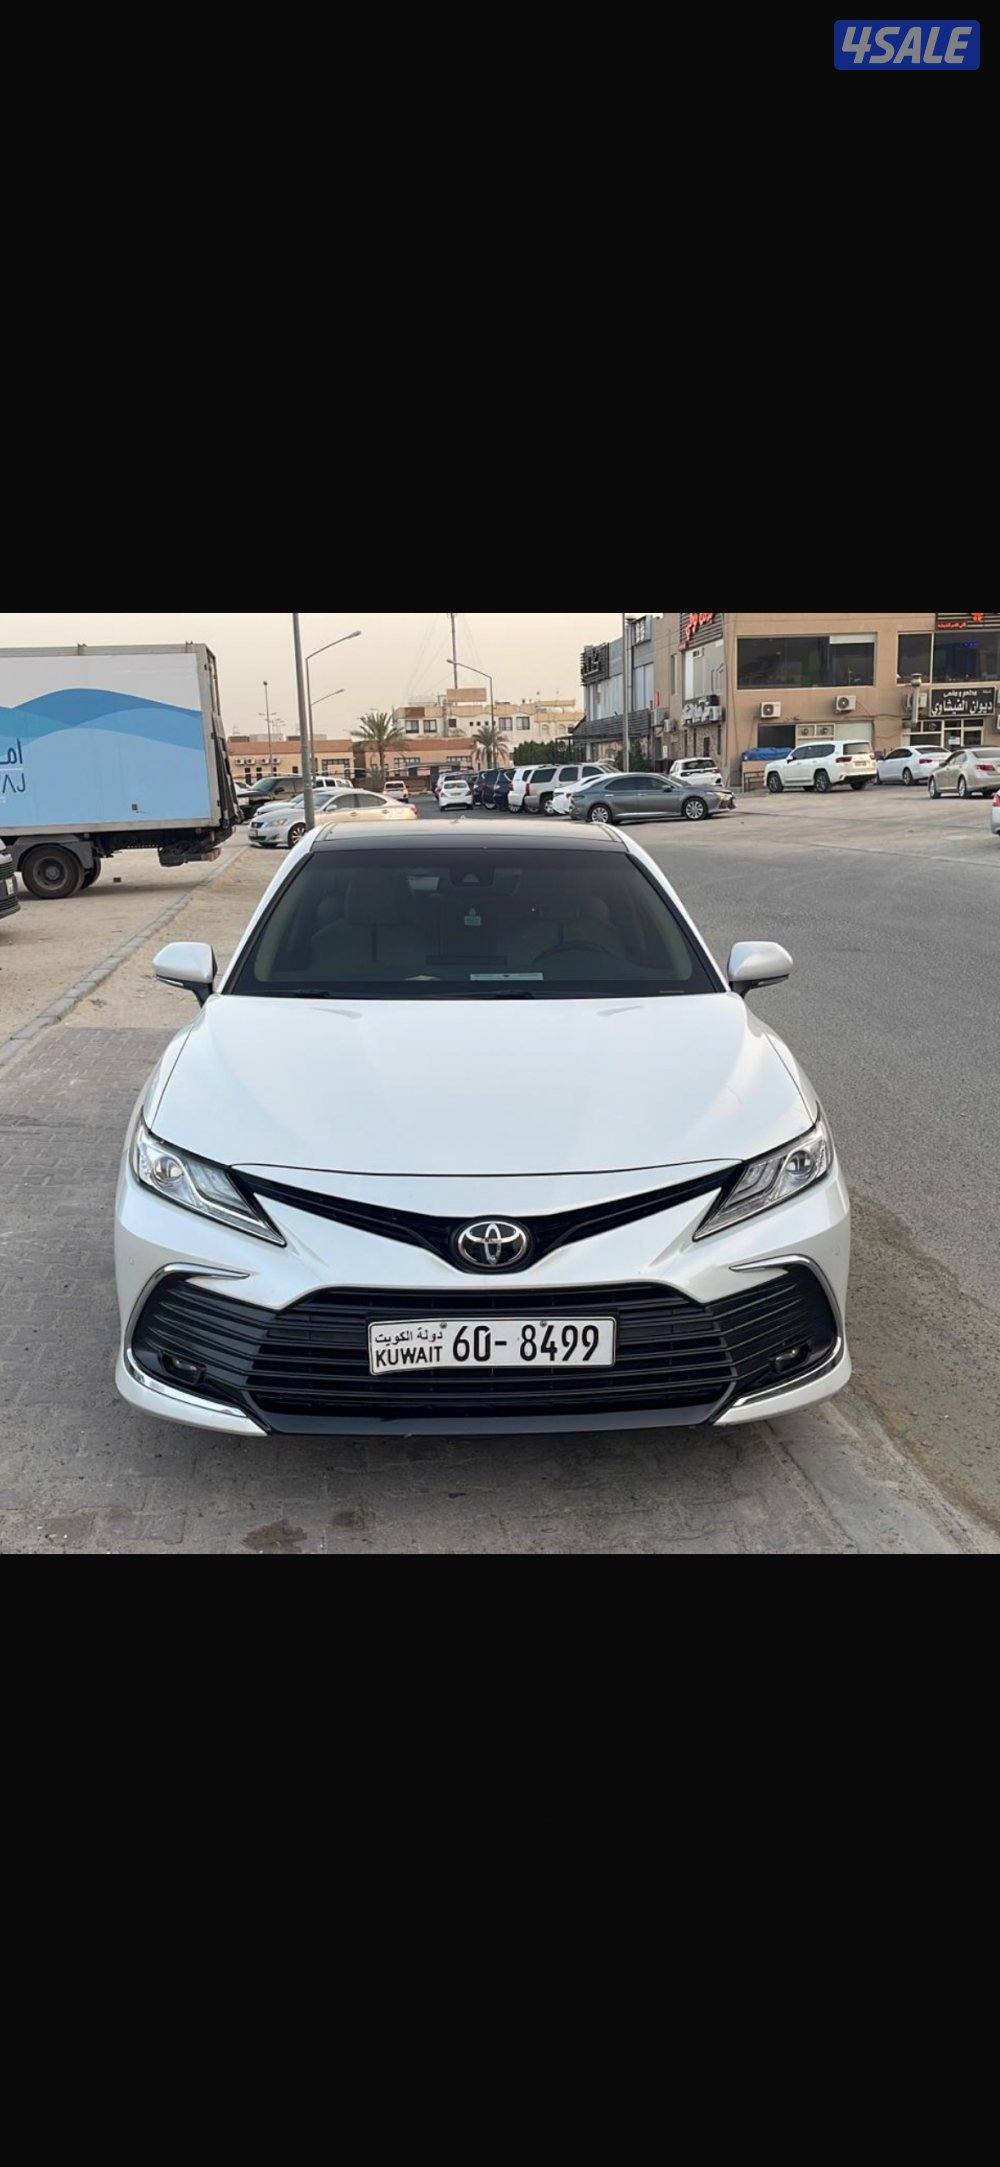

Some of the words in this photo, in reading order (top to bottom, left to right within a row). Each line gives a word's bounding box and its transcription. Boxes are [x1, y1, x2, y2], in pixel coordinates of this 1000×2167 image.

[374, 1331, 413, 1345] الكويت
[417, 1328, 443, 1341] دولة
[519, 1324, 599, 1361] 8499
[375, 1346, 443, 1367] KUWAIT
